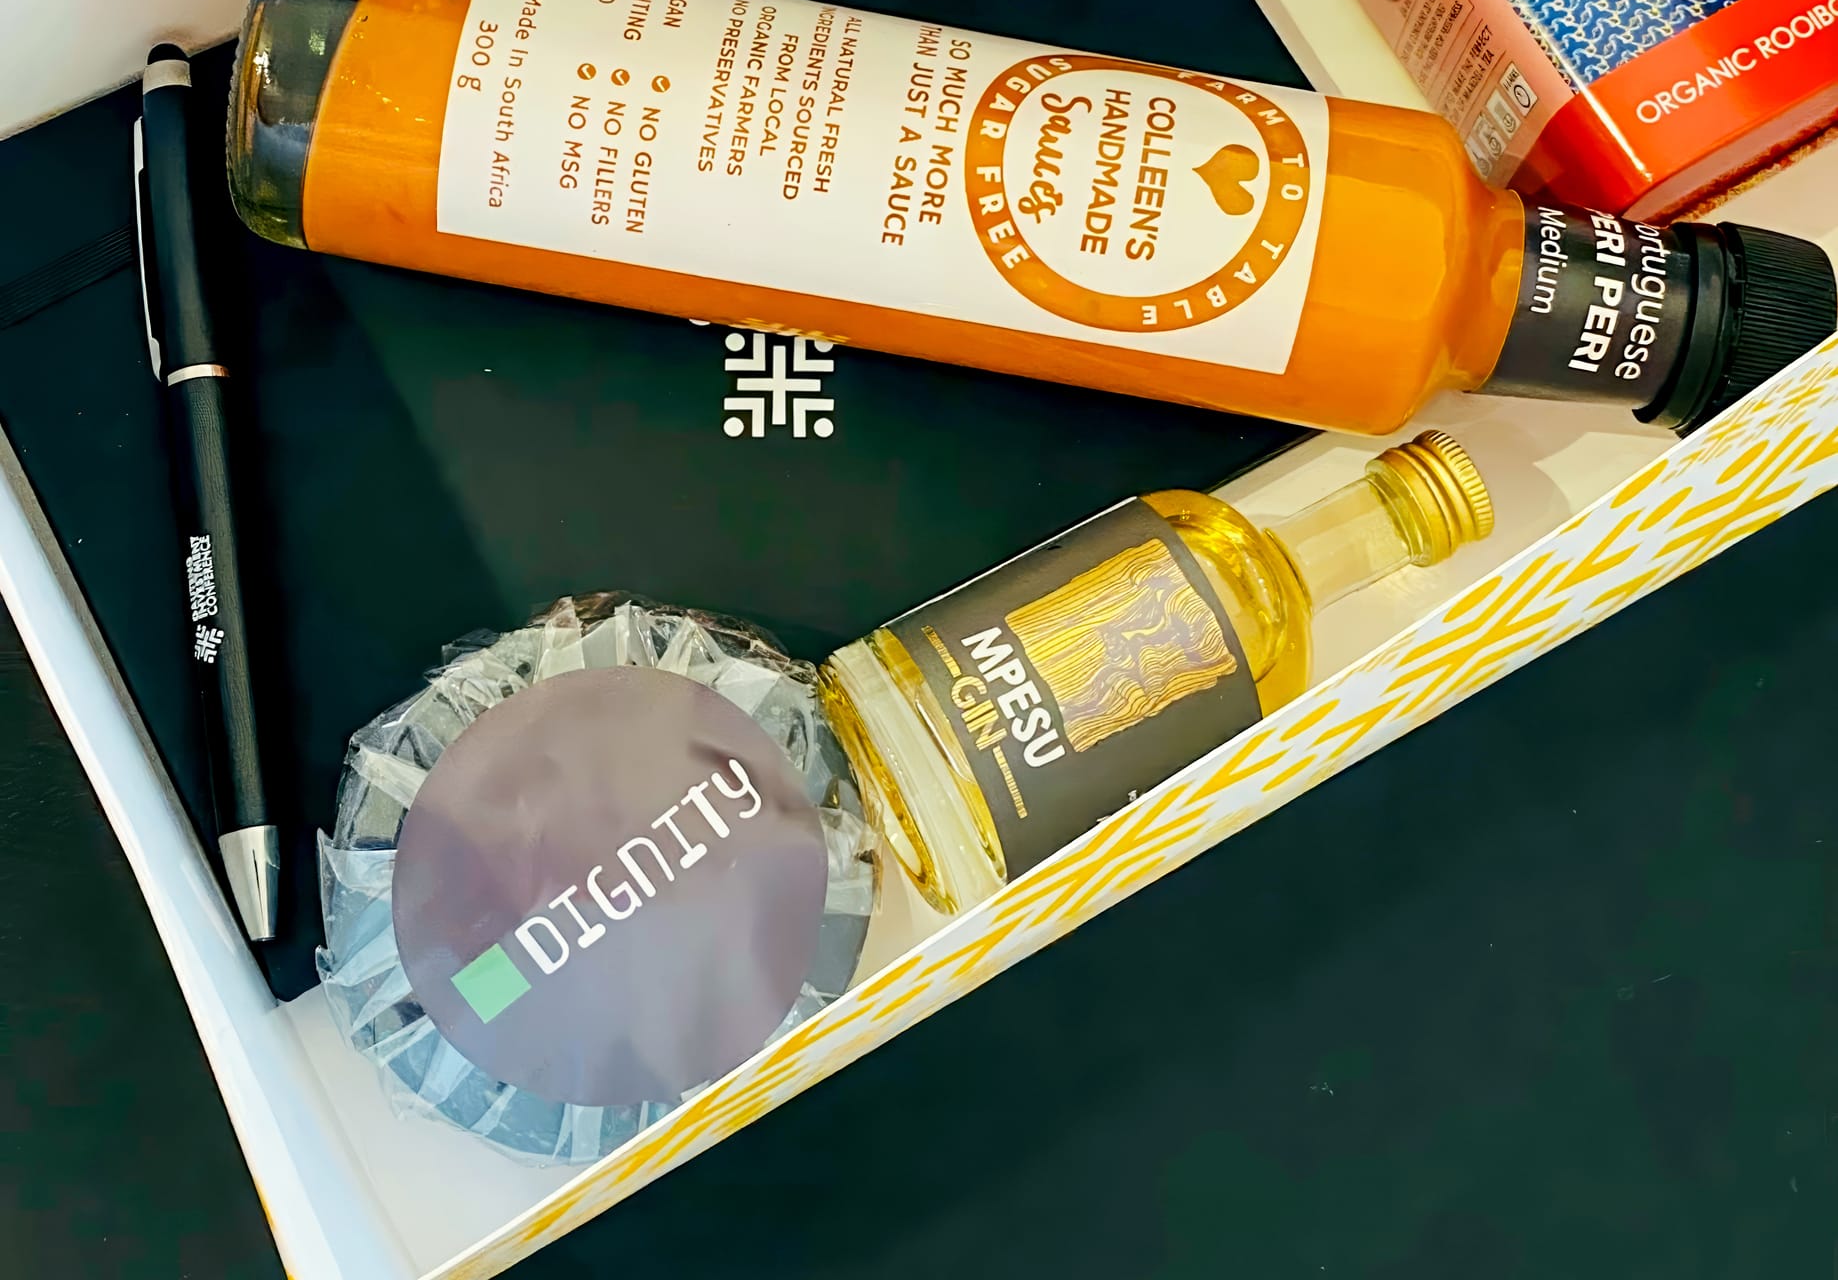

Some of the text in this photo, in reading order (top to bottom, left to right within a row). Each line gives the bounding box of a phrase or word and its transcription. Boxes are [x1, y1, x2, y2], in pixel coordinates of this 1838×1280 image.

[457, 20, 498, 92] 300 g
[494, 77, 522, 142] South
[508, 49, 529, 68] In
[697, 0, 750, 173] NO PRESERVATIVES
[726, 5, 777, 176] ORGANIC FARMERS
[759, 33, 799, 156] FROM LOCAL
[813, 15, 862, 193] ALL NATURAL FRESH
[1636, 46, 1757, 125] ORGANIC
[488, 150, 511, 209] Africa
[559, 95, 591, 189] NO MSG
[591, 101, 626, 226] NO FILLERS
[625, 107, 662, 234] NO GLUTEN
[783, 95, 815, 200] SOURCED
[881, 24, 943, 246] THAN JUST A SAUCE
[918, 38, 972, 225] SO MUCH MORE
[976, 56, 1073, 269] SUGAR FREE
[1018, 92, 1093, 224] Sauces
[1080, 87, 1132, 255] HANDMADE
[1124, 96, 1177, 261] COLLEEN'S
[1141, 71, 1304, 326] FARM TO TABLE
[1530, 206, 1569, 314] Medium
[1568, 213, 1627, 373] ERI PERI
[1614, 223, 1672, 380] ortuguese
[199, 533, 219, 617] CONFERENCE
[950, 676, 1009, 752] GIN
[961, 625, 1068, 769] MPESU
